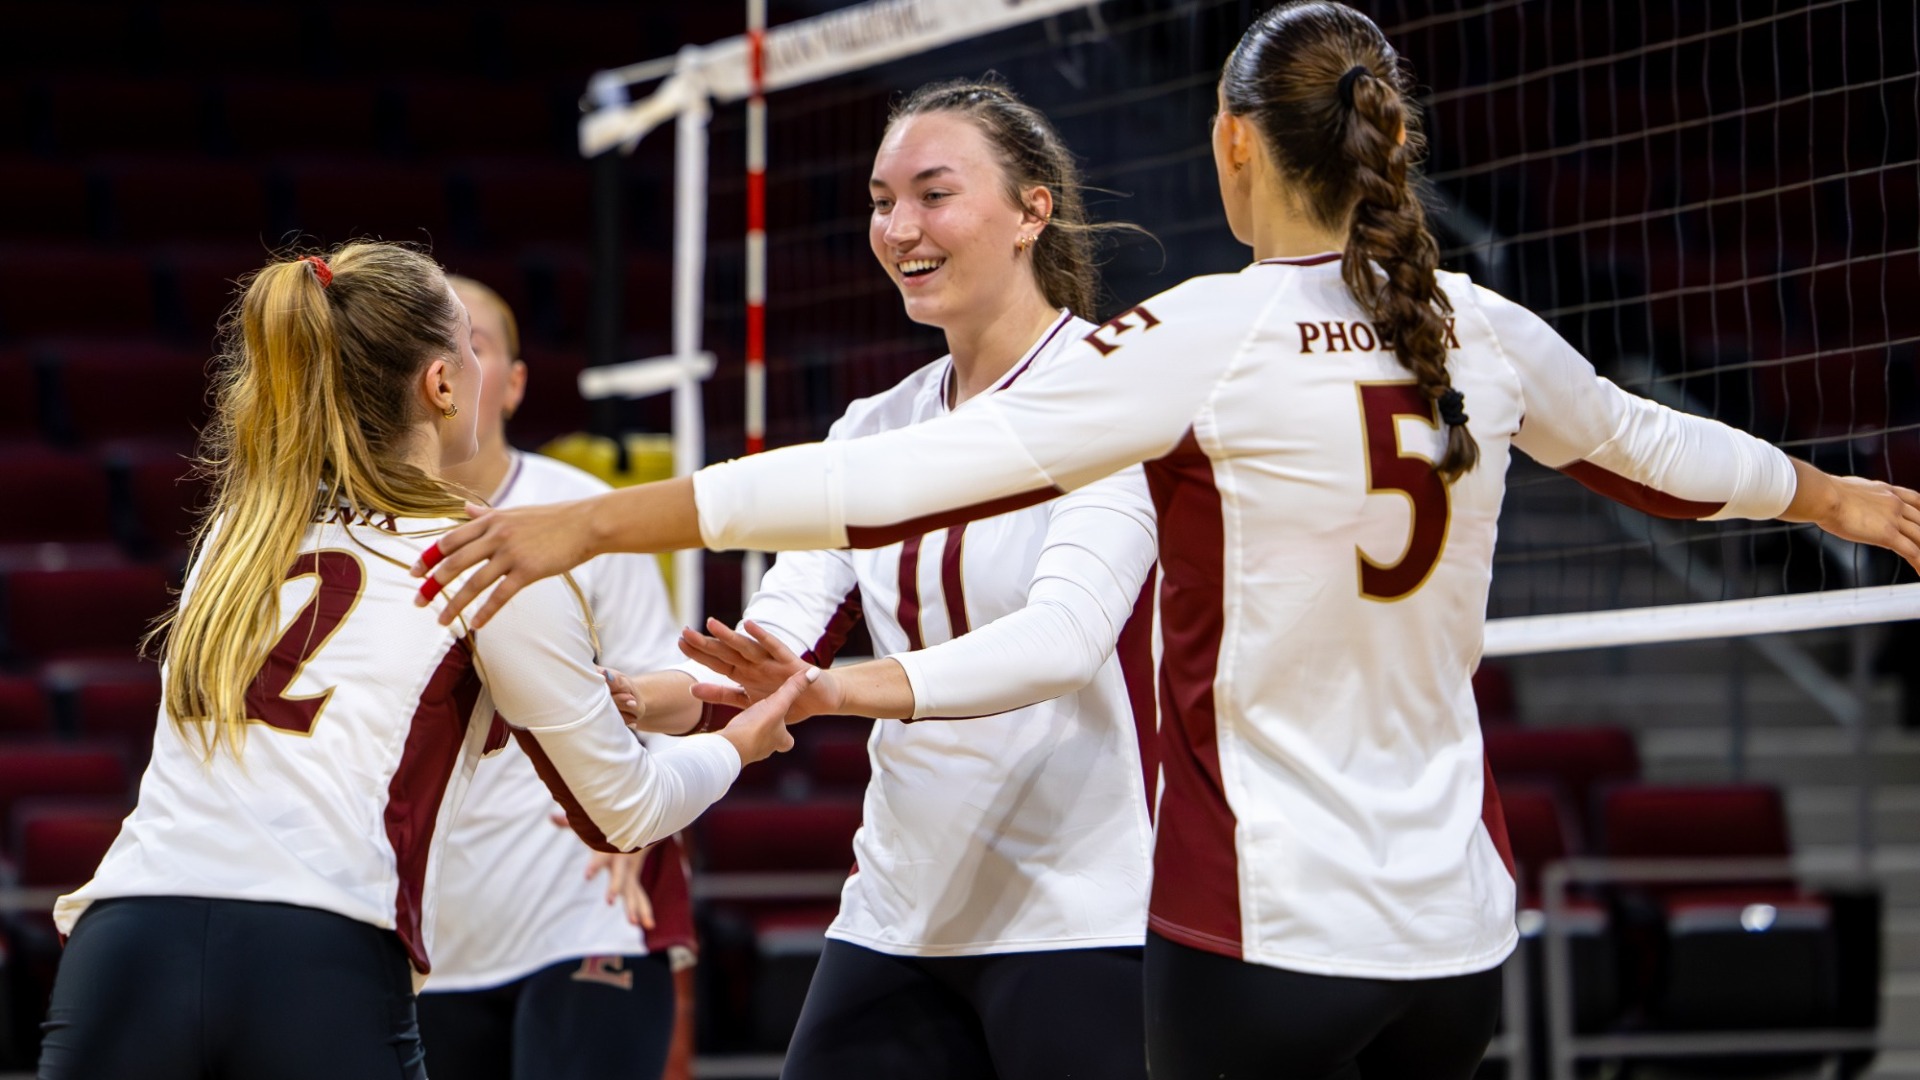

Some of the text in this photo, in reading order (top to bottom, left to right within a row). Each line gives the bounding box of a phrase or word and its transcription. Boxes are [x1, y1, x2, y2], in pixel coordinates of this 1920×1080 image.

[1296, 318, 1461, 354] PHOEX
[1355, 380, 1451, 603] 5
[176, 547, 367, 738] 2
[896, 521, 972, 652] 11
